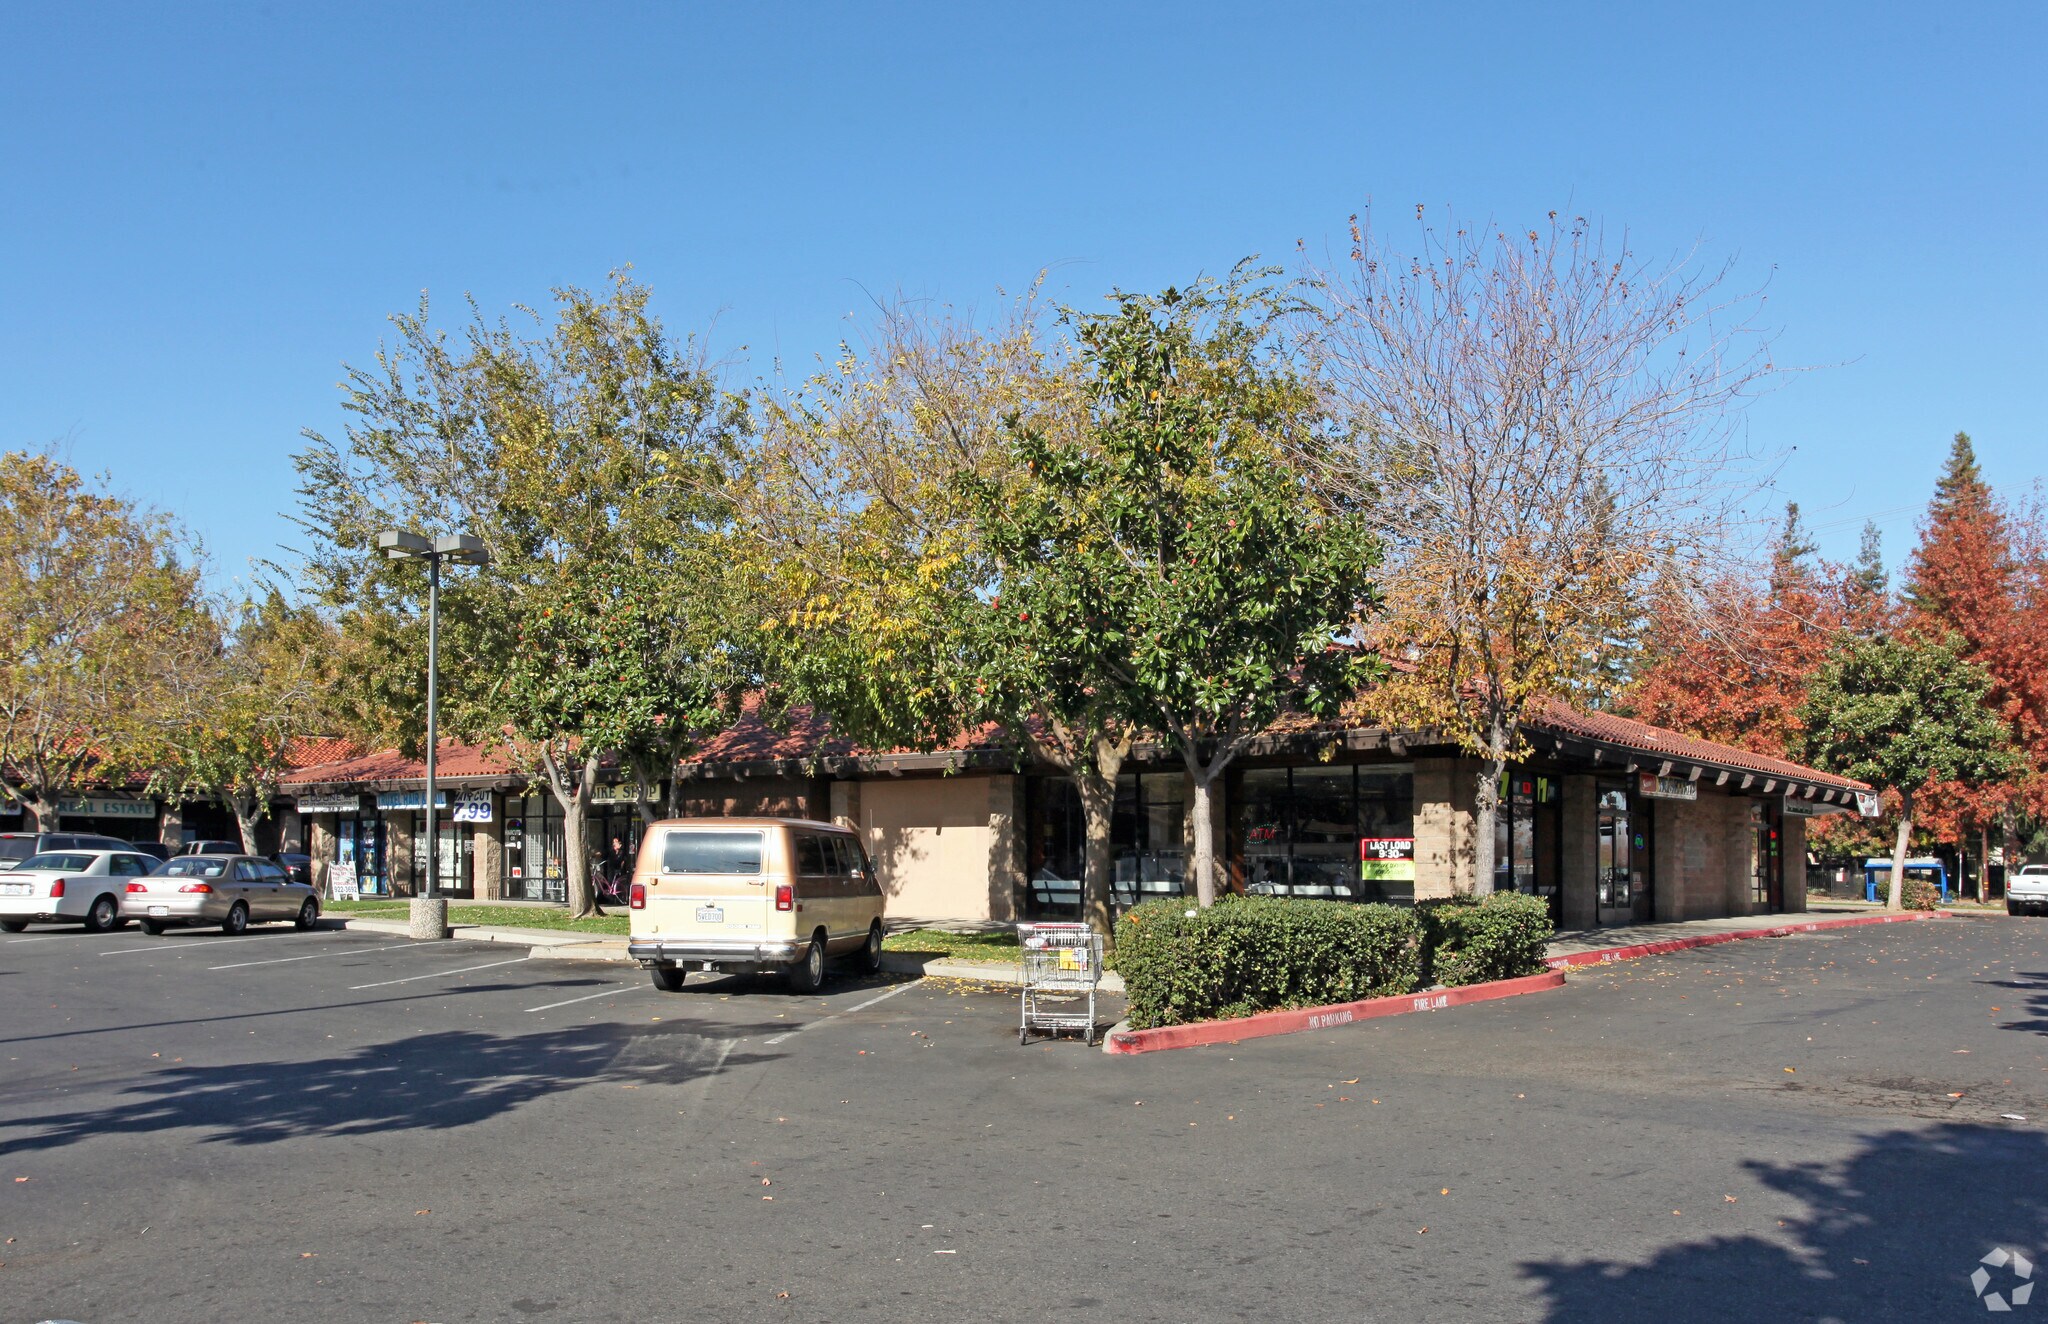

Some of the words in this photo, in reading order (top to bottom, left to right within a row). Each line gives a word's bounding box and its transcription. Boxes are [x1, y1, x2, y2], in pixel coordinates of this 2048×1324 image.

[622, 784, 657, 798] SHP
[103, 802, 153, 814] ESTATE
[454, 801, 492, 820] 7.99
[1249, 828, 1276, 839] ATM
[1369, 841, 1389, 850] LAST
[1390, 840, 1411, 850] LOAD
[1413, 997, 1430, 1011] FIRE
[1430, 995, 1449, 1009] LANE
[1309, 1014, 1320, 1029] NO
[1320, 1010, 1353, 1028] PARKING
